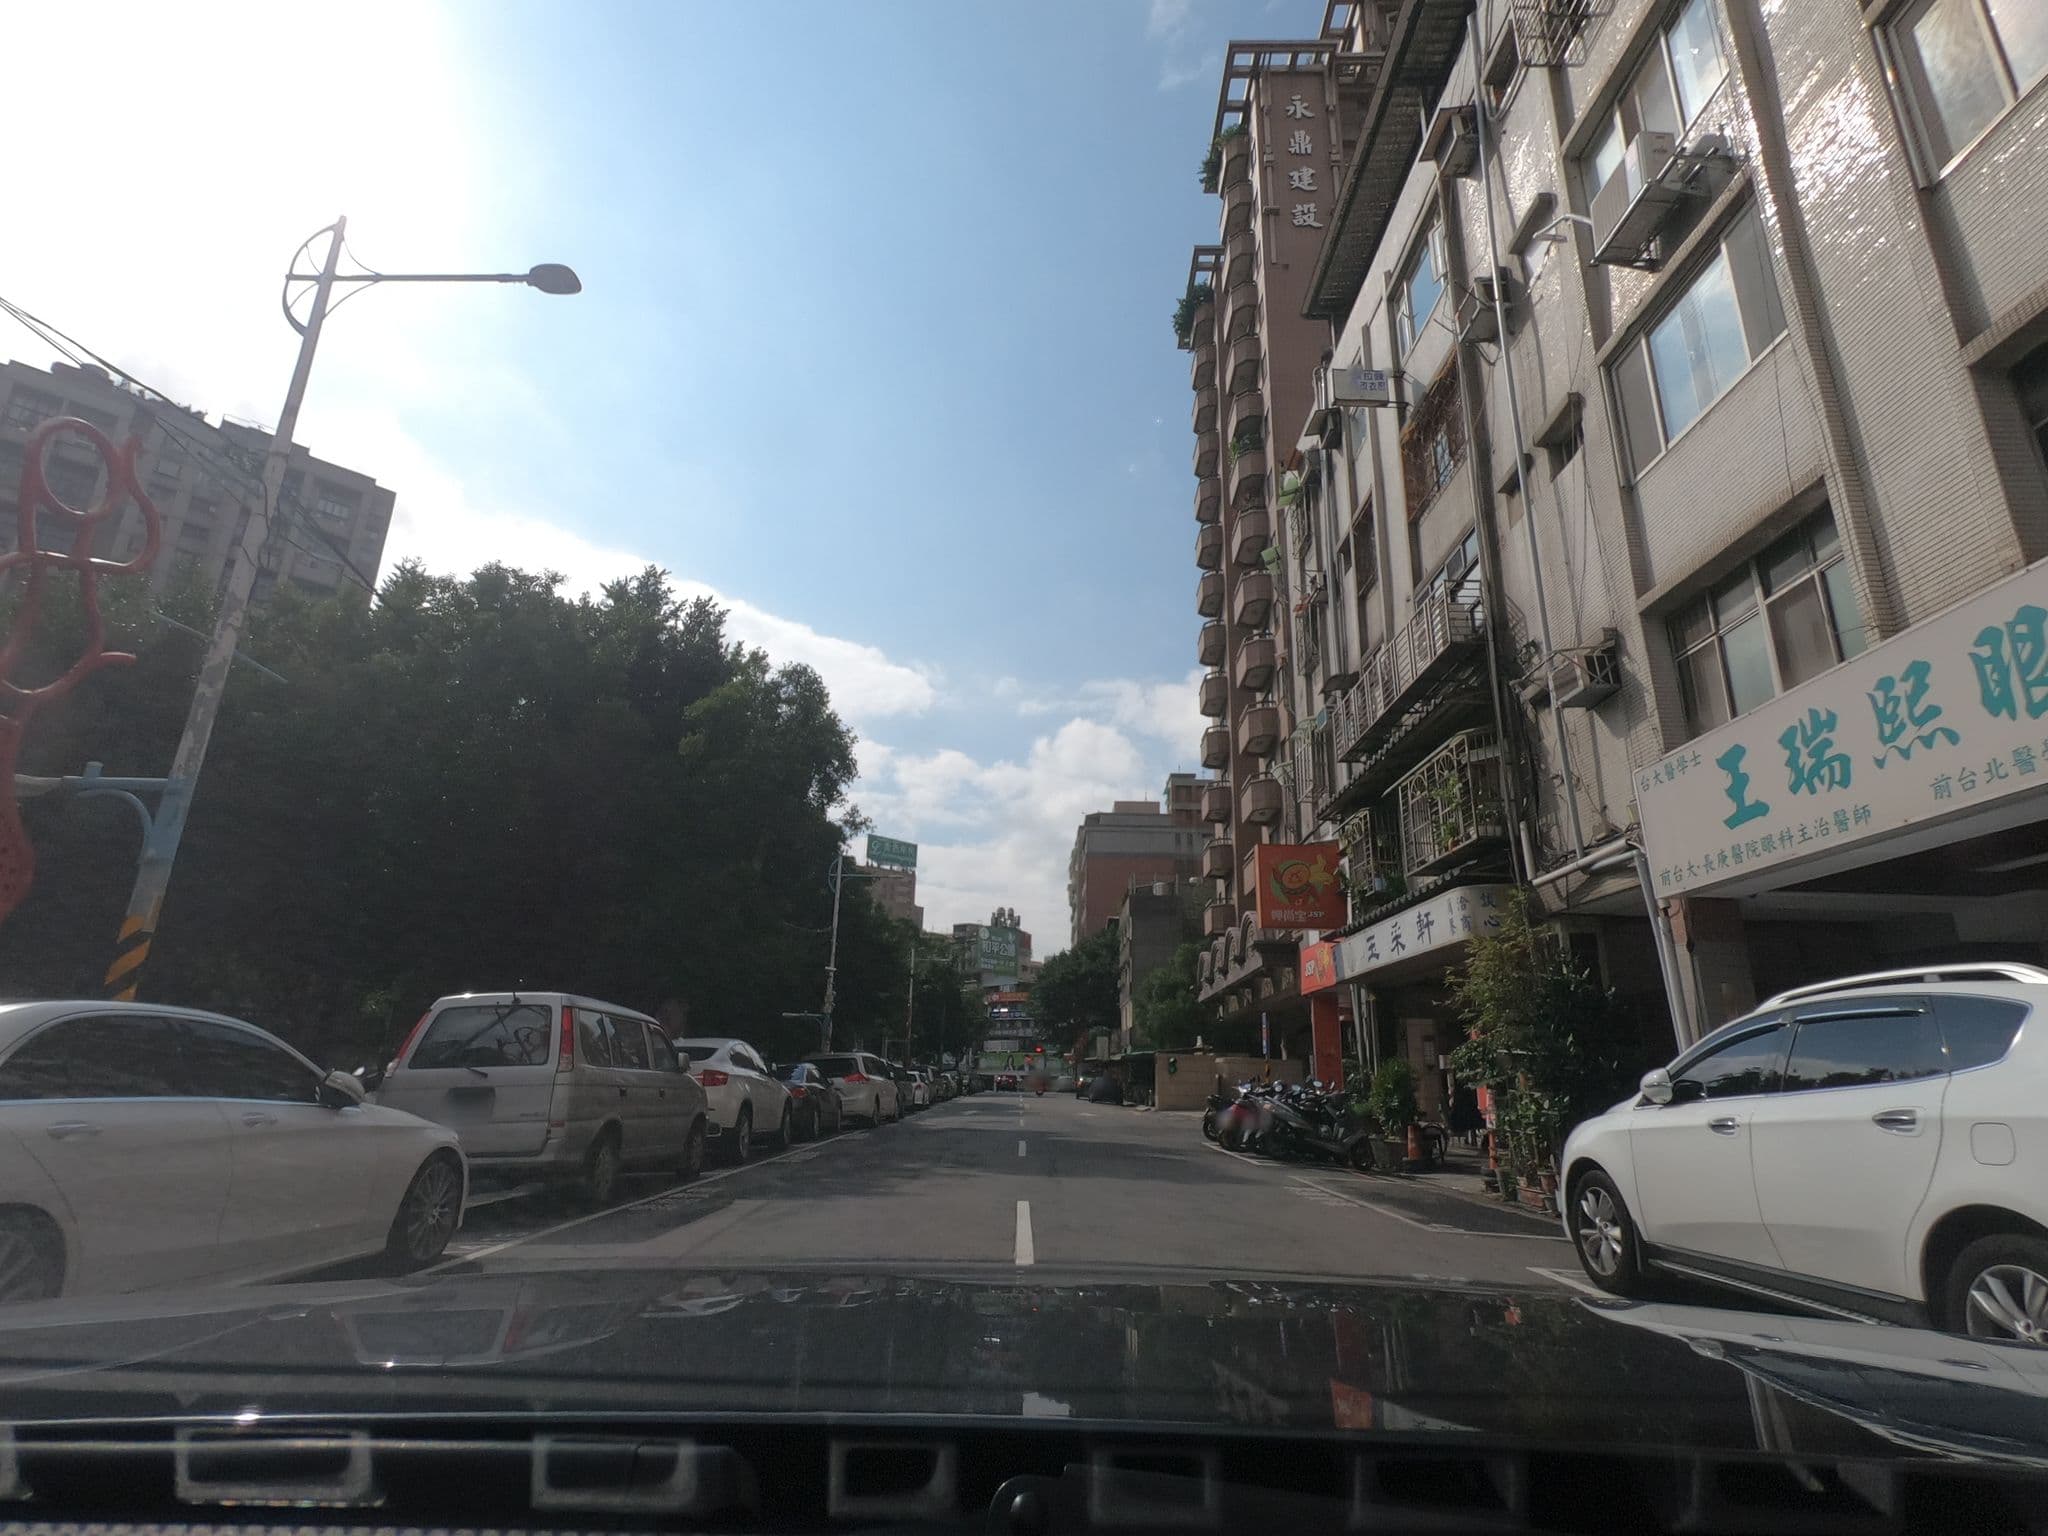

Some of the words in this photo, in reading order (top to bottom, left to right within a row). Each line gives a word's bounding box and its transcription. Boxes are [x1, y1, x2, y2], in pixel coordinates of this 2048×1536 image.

[1285, 94, 1324, 229] 永鼎建設
[1640, 750, 1702, 793] 台大醫學士
